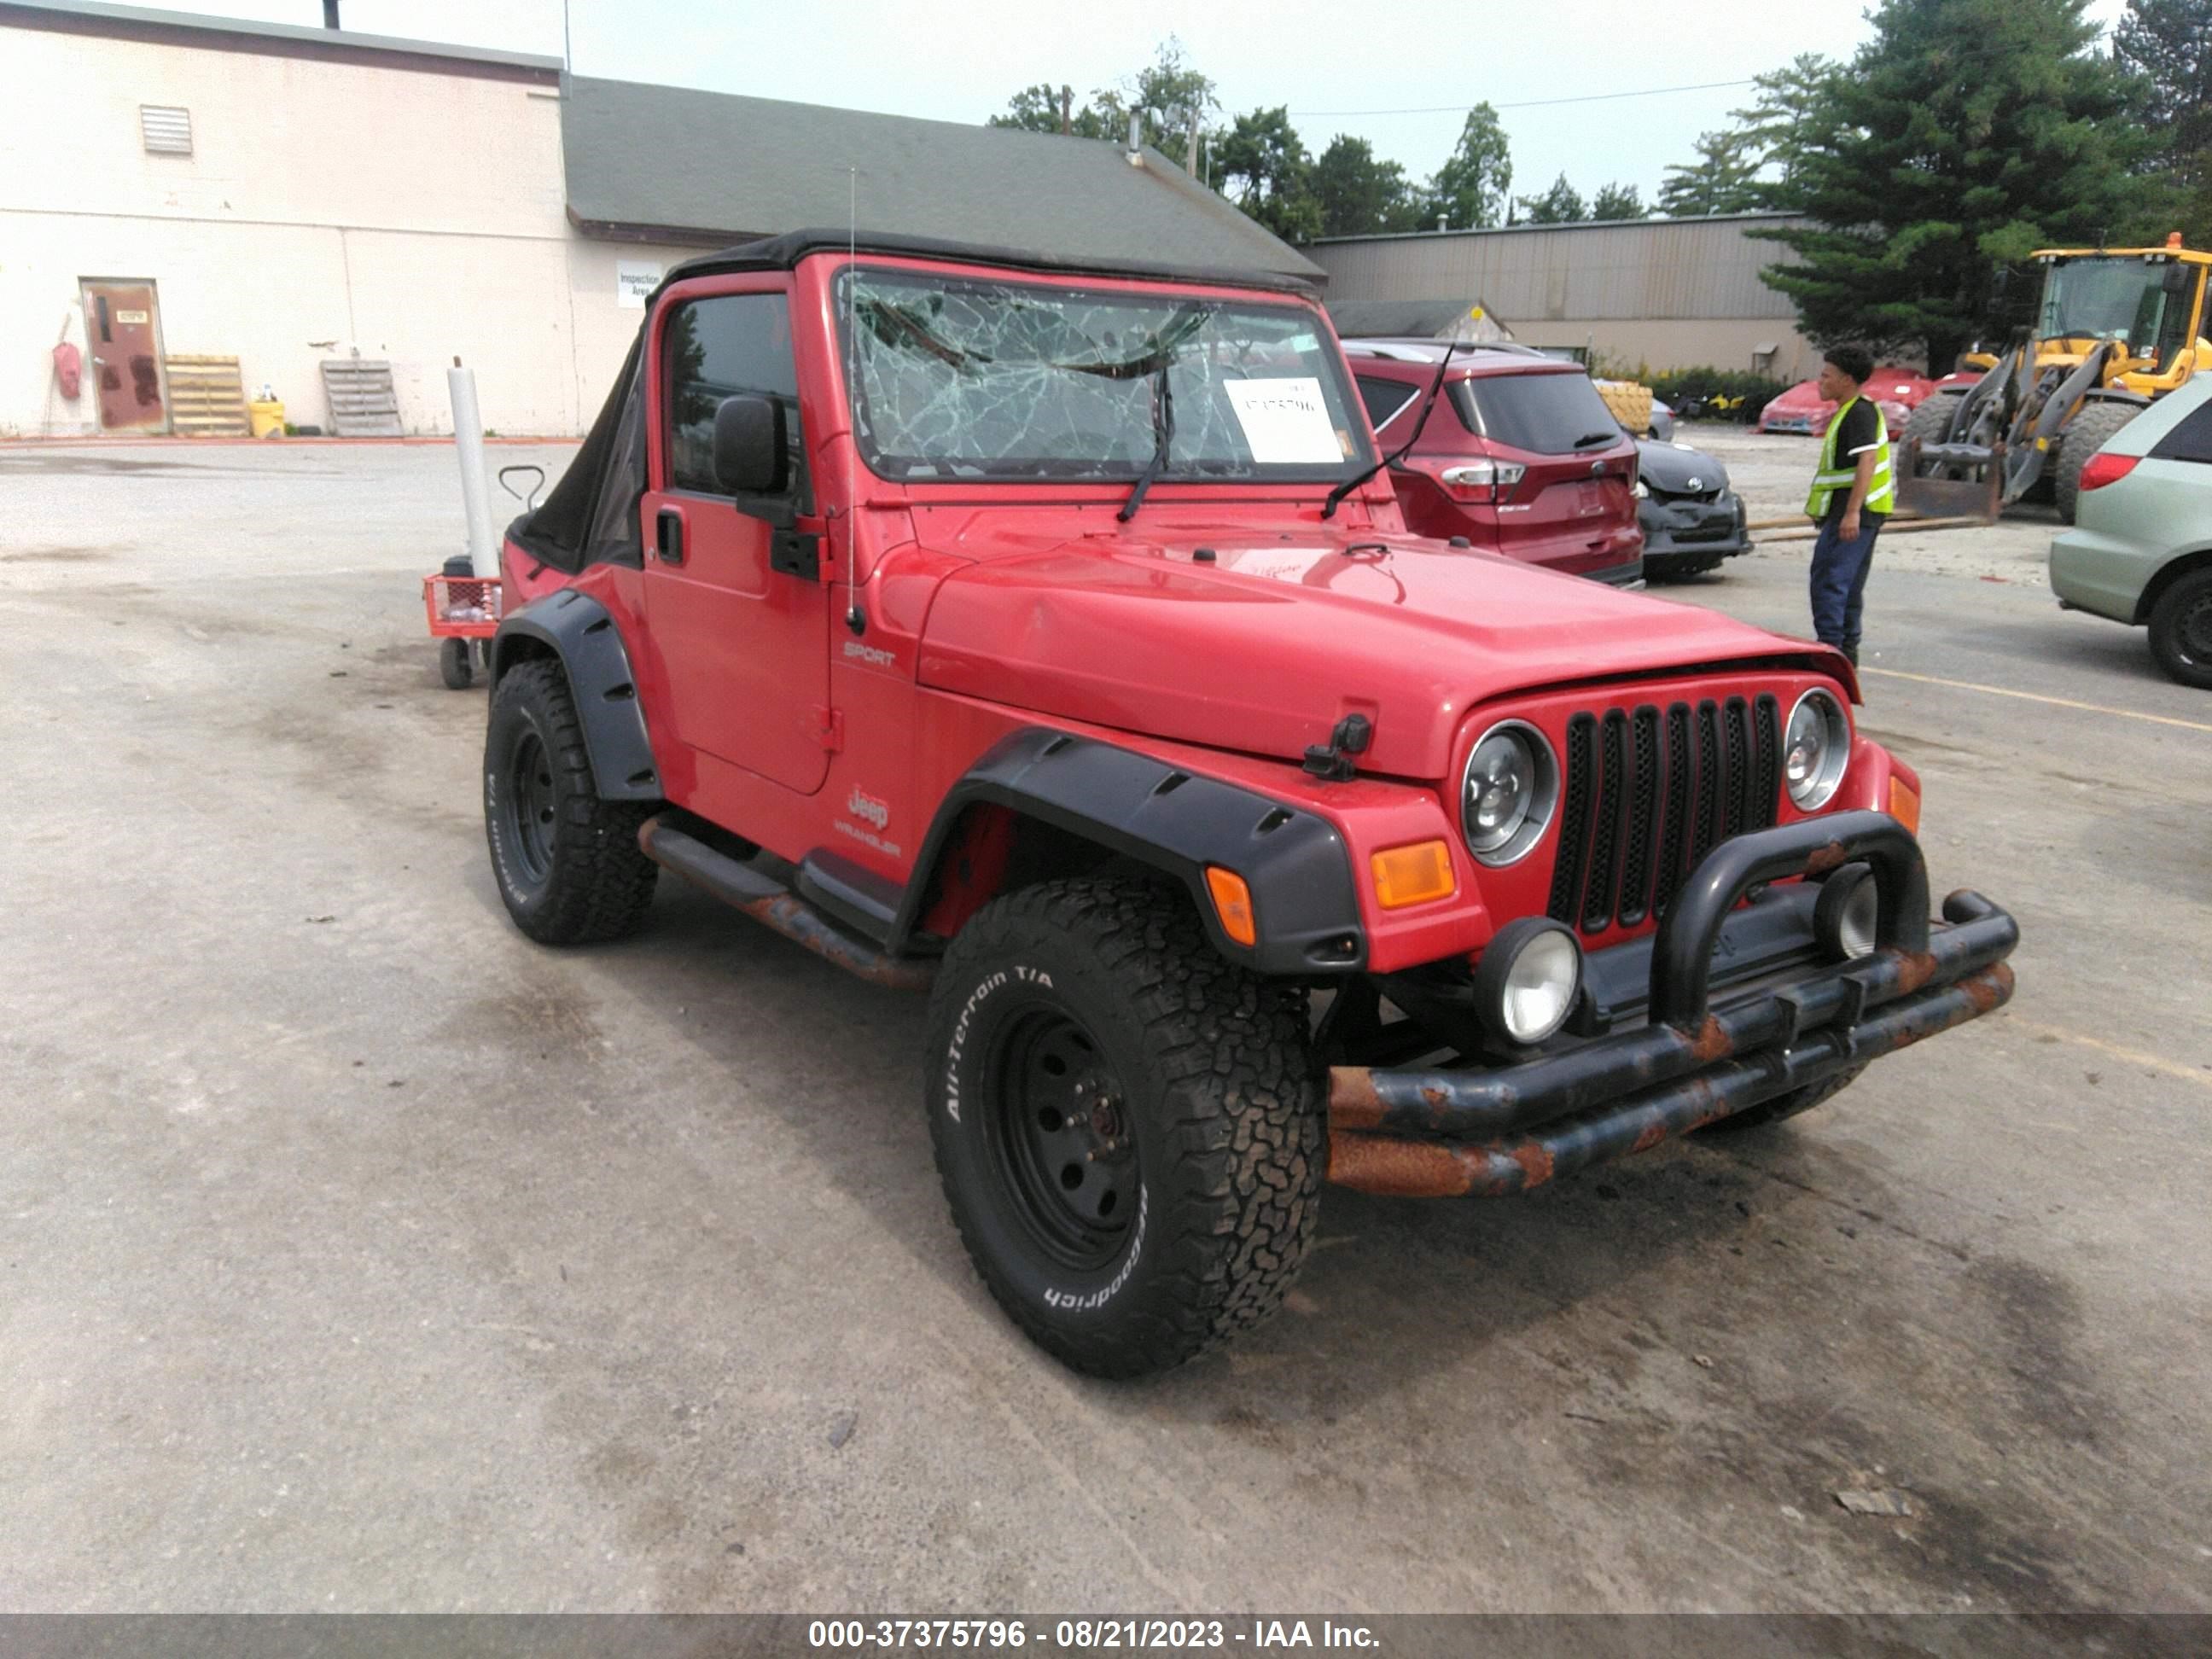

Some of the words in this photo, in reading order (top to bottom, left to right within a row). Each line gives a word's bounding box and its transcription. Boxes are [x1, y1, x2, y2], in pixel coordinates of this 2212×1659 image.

[620, 273, 661, 284] Inspection
[844, 642, 895, 667] SPORT
[848, 787, 888, 830] Jeep
[833, 819, 902, 859] WRANGLER
[946, 971, 1007, 1123] All-Terrain
[1015, 965, 1053, 988] T/A
